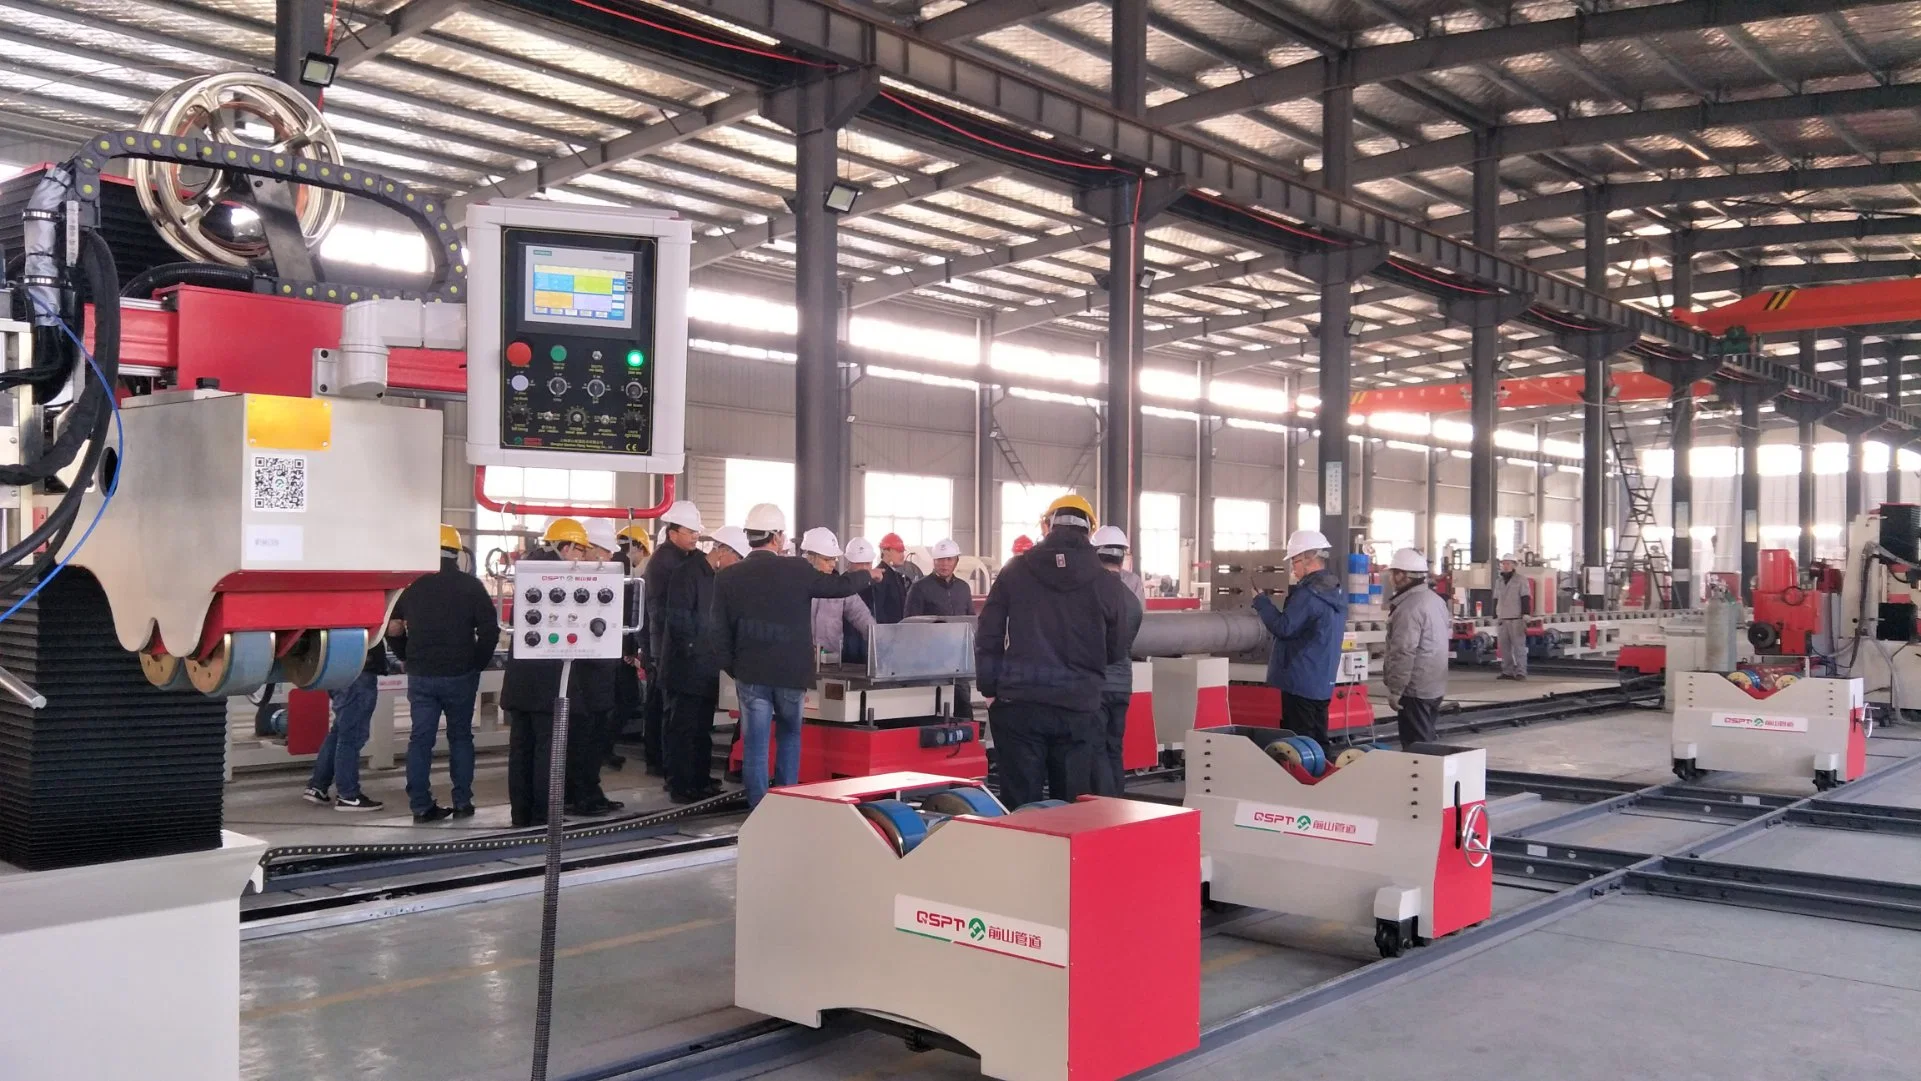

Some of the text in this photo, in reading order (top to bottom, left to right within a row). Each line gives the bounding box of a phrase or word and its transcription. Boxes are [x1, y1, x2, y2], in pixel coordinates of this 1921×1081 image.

[1253, 811, 1295, 826] QSPT
[916, 910, 1042, 950] QSPT 前山管道
